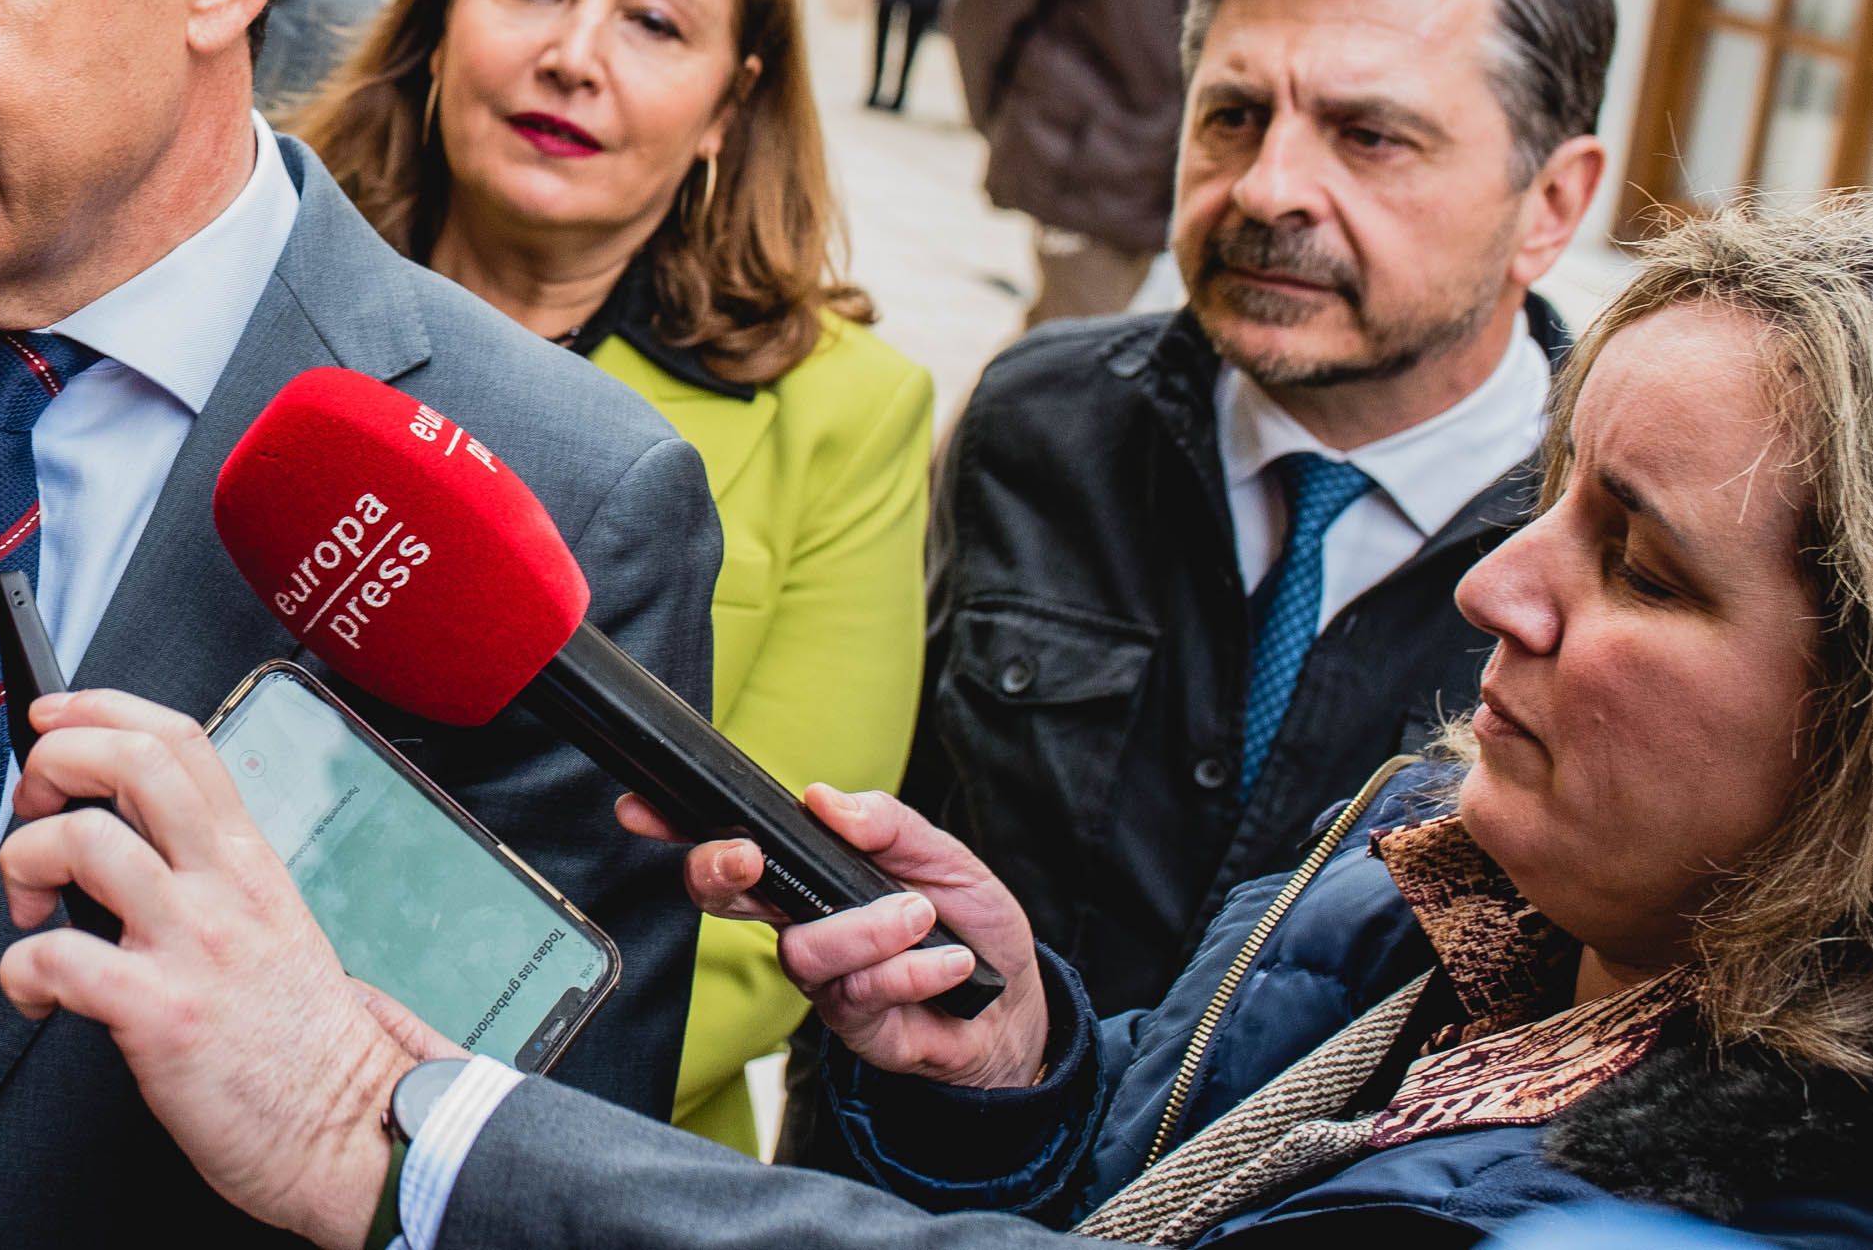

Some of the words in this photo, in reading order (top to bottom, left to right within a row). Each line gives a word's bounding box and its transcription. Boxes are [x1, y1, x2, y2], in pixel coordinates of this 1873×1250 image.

[274, 493, 389, 616] europa
[329, 535, 431, 649] press
[518, 961, 538, 981] las
[533, 928, 567, 963] Todas
[461, 978, 521, 1052] grabaciones
